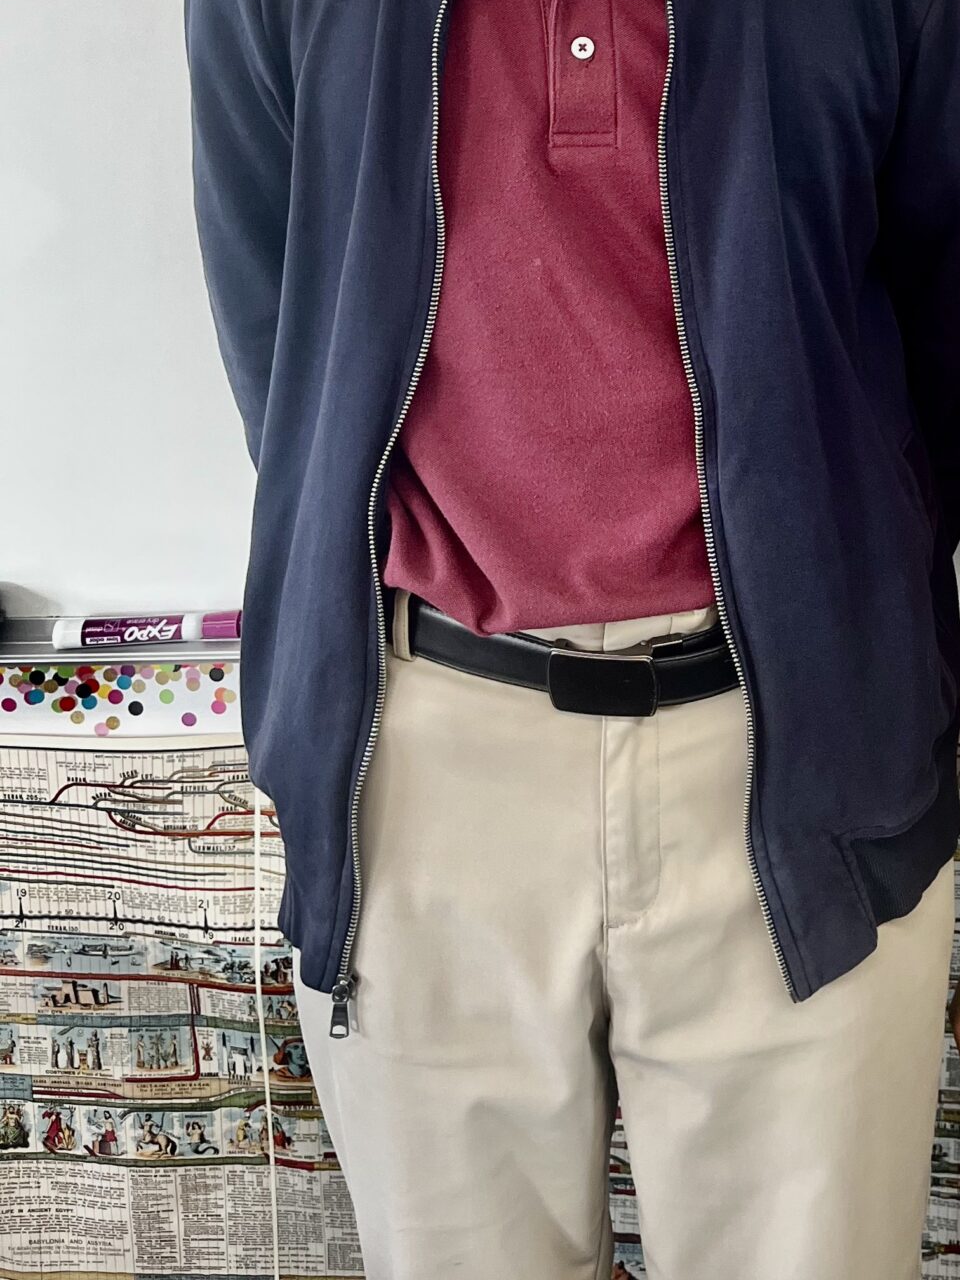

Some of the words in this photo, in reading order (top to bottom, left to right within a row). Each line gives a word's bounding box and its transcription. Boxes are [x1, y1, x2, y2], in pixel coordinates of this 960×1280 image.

[123, 619, 179, 642] EXPO
[16, 888, 27, 897] 19
[107, 891, 121, 900] 20
[198, 900, 210, 909] 21
[14, 919, 27, 929] 21
[109, 922, 125, 931] 20
[202, 931, 214, 940] 19
